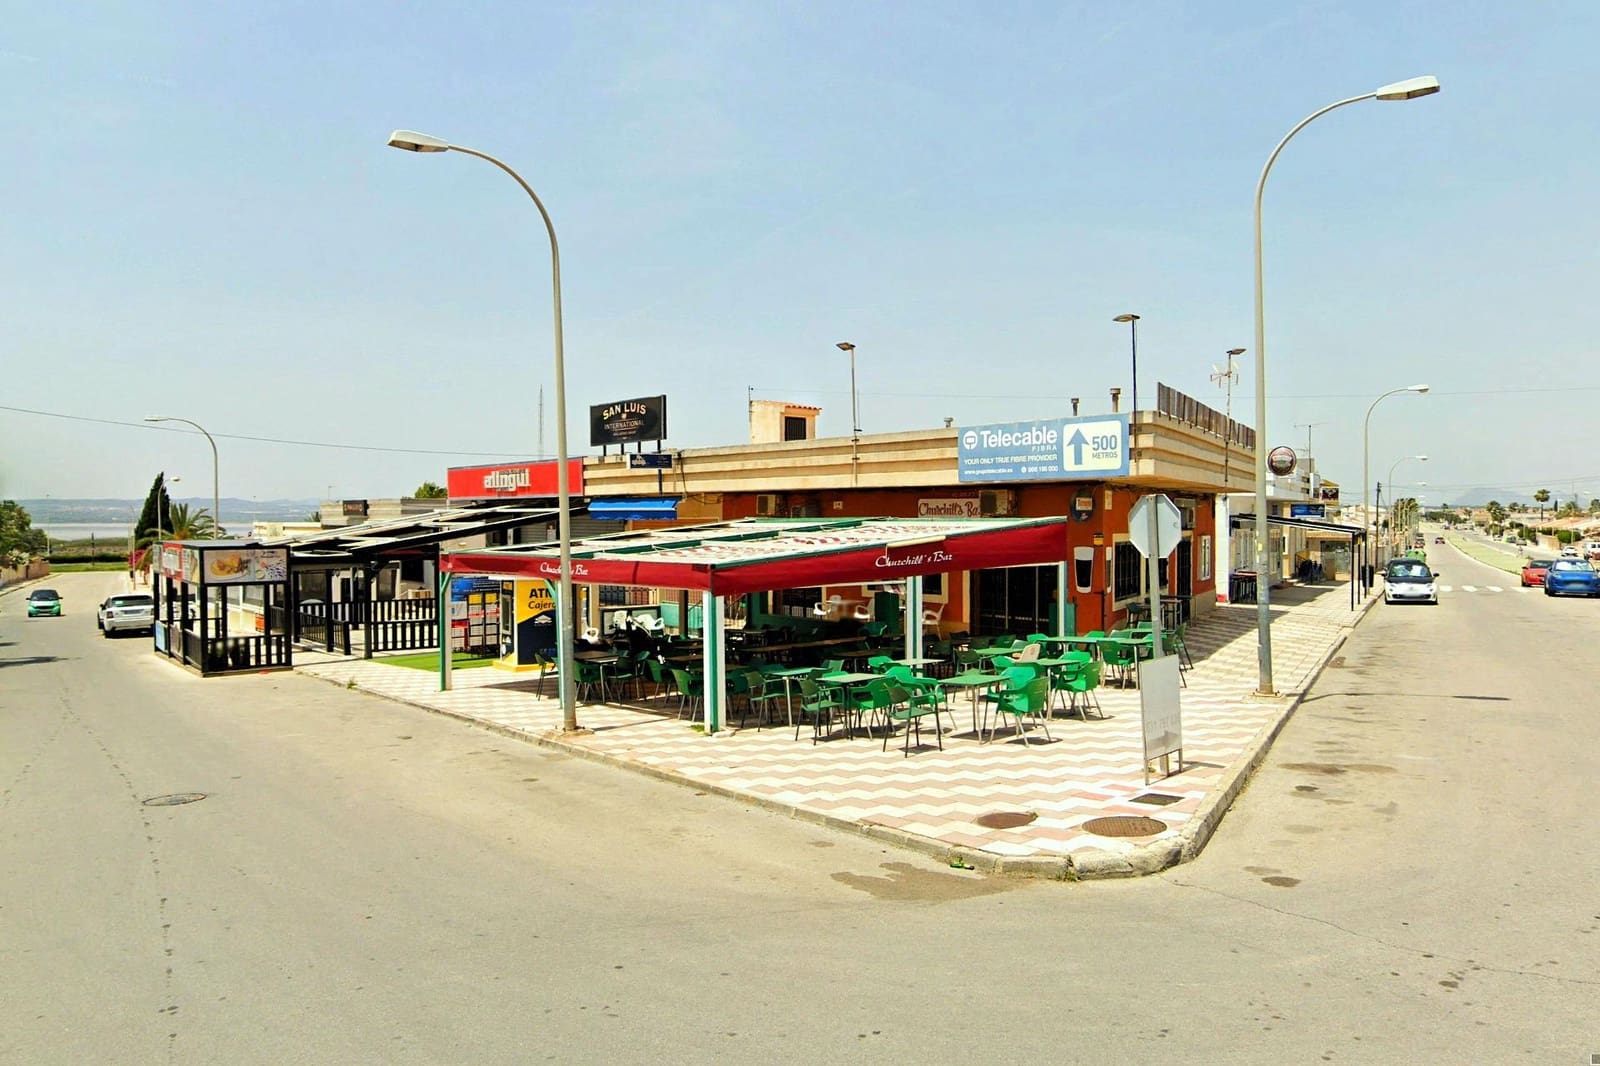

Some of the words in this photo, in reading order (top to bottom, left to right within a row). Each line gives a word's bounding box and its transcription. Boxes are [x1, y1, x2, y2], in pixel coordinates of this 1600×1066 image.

[602, 404, 621, 420] SAN
[624, 402, 647, 414] LUIS
[604, 420, 644, 430] INTERNATIONAL
[980, 426, 1058, 448] Telecable
[1092, 435, 1118, 451] 500
[964, 457, 979, 465] YOUR
[995, 456, 1009, 464] TRUE
[1010, 455, 1026, 463] FIBRE
[1027, 453, 1058, 462] PROVIDER
[1092, 451, 1118, 459] METROS
[919, 501, 964, 516] Churchill's
[875, 554, 932, 567] Churchill's
[932, 550, 953, 562] Bar
